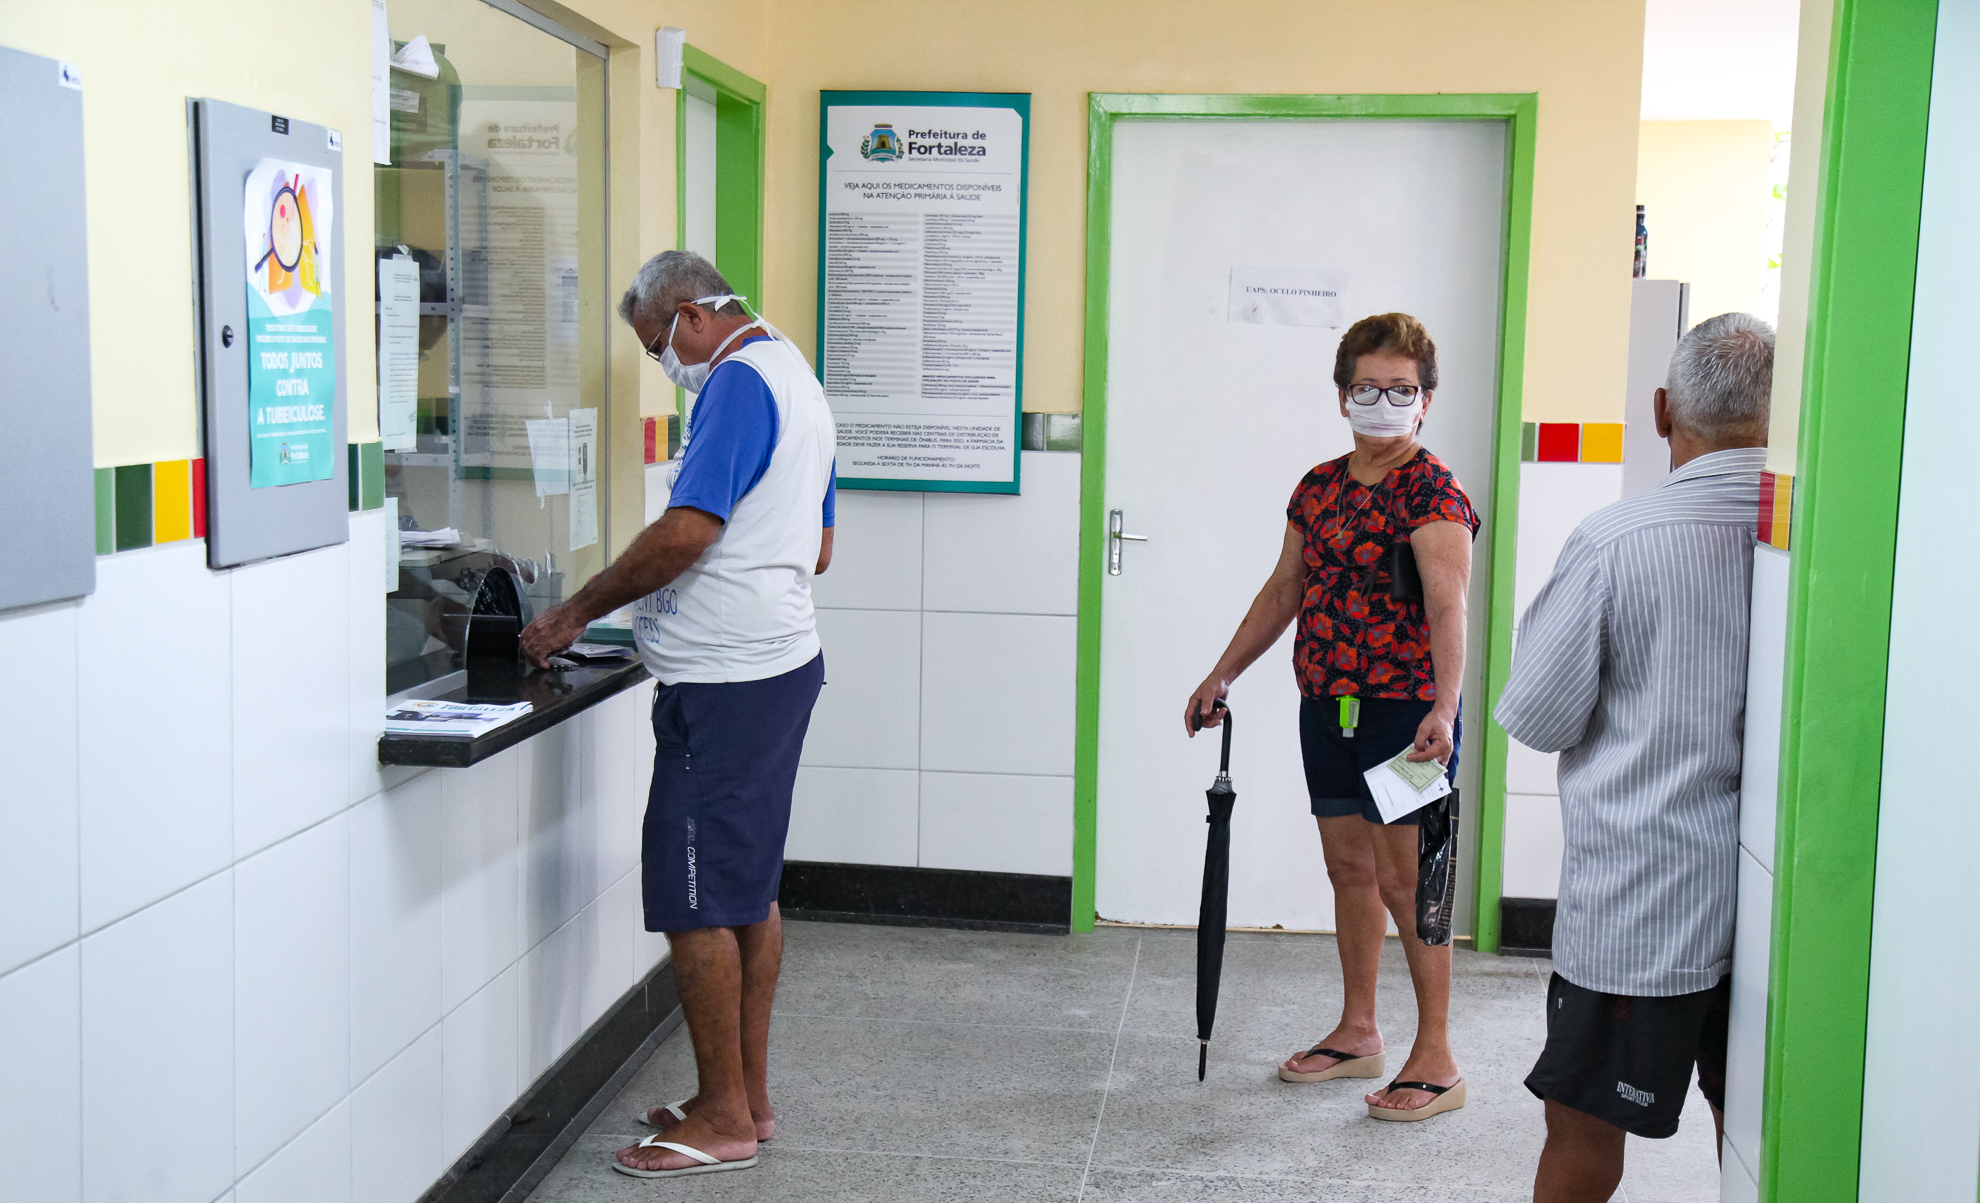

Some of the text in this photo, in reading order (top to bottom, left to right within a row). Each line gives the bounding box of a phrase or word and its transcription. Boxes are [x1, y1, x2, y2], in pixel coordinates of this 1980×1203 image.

[908, 129, 986, 140] Prefeitura de
[908, 142, 986, 156] Fortaleza
[956, 183, 1002, 191] DISPONÍVEIS
[876, 191, 912, 201] ATENÇÃO
[914, 192, 948, 200] PRIMÁRIA
[956, 193, 981, 201] SAÚDE
[1299, 289, 1337, 298] PINHEIRO
[260, 352, 323, 373] TODOS JUNTOS
[276, 379, 309, 397] CONTRA
[257, 404, 326, 425] A TUBERCULOSE.
[656, 588, 678, 615] BGO
[687, 846, 698, 910] COMPETITION
[1617, 1081, 1655, 1103] INTERATIVA
[1621, 1094, 1635, 1102] SPORT
